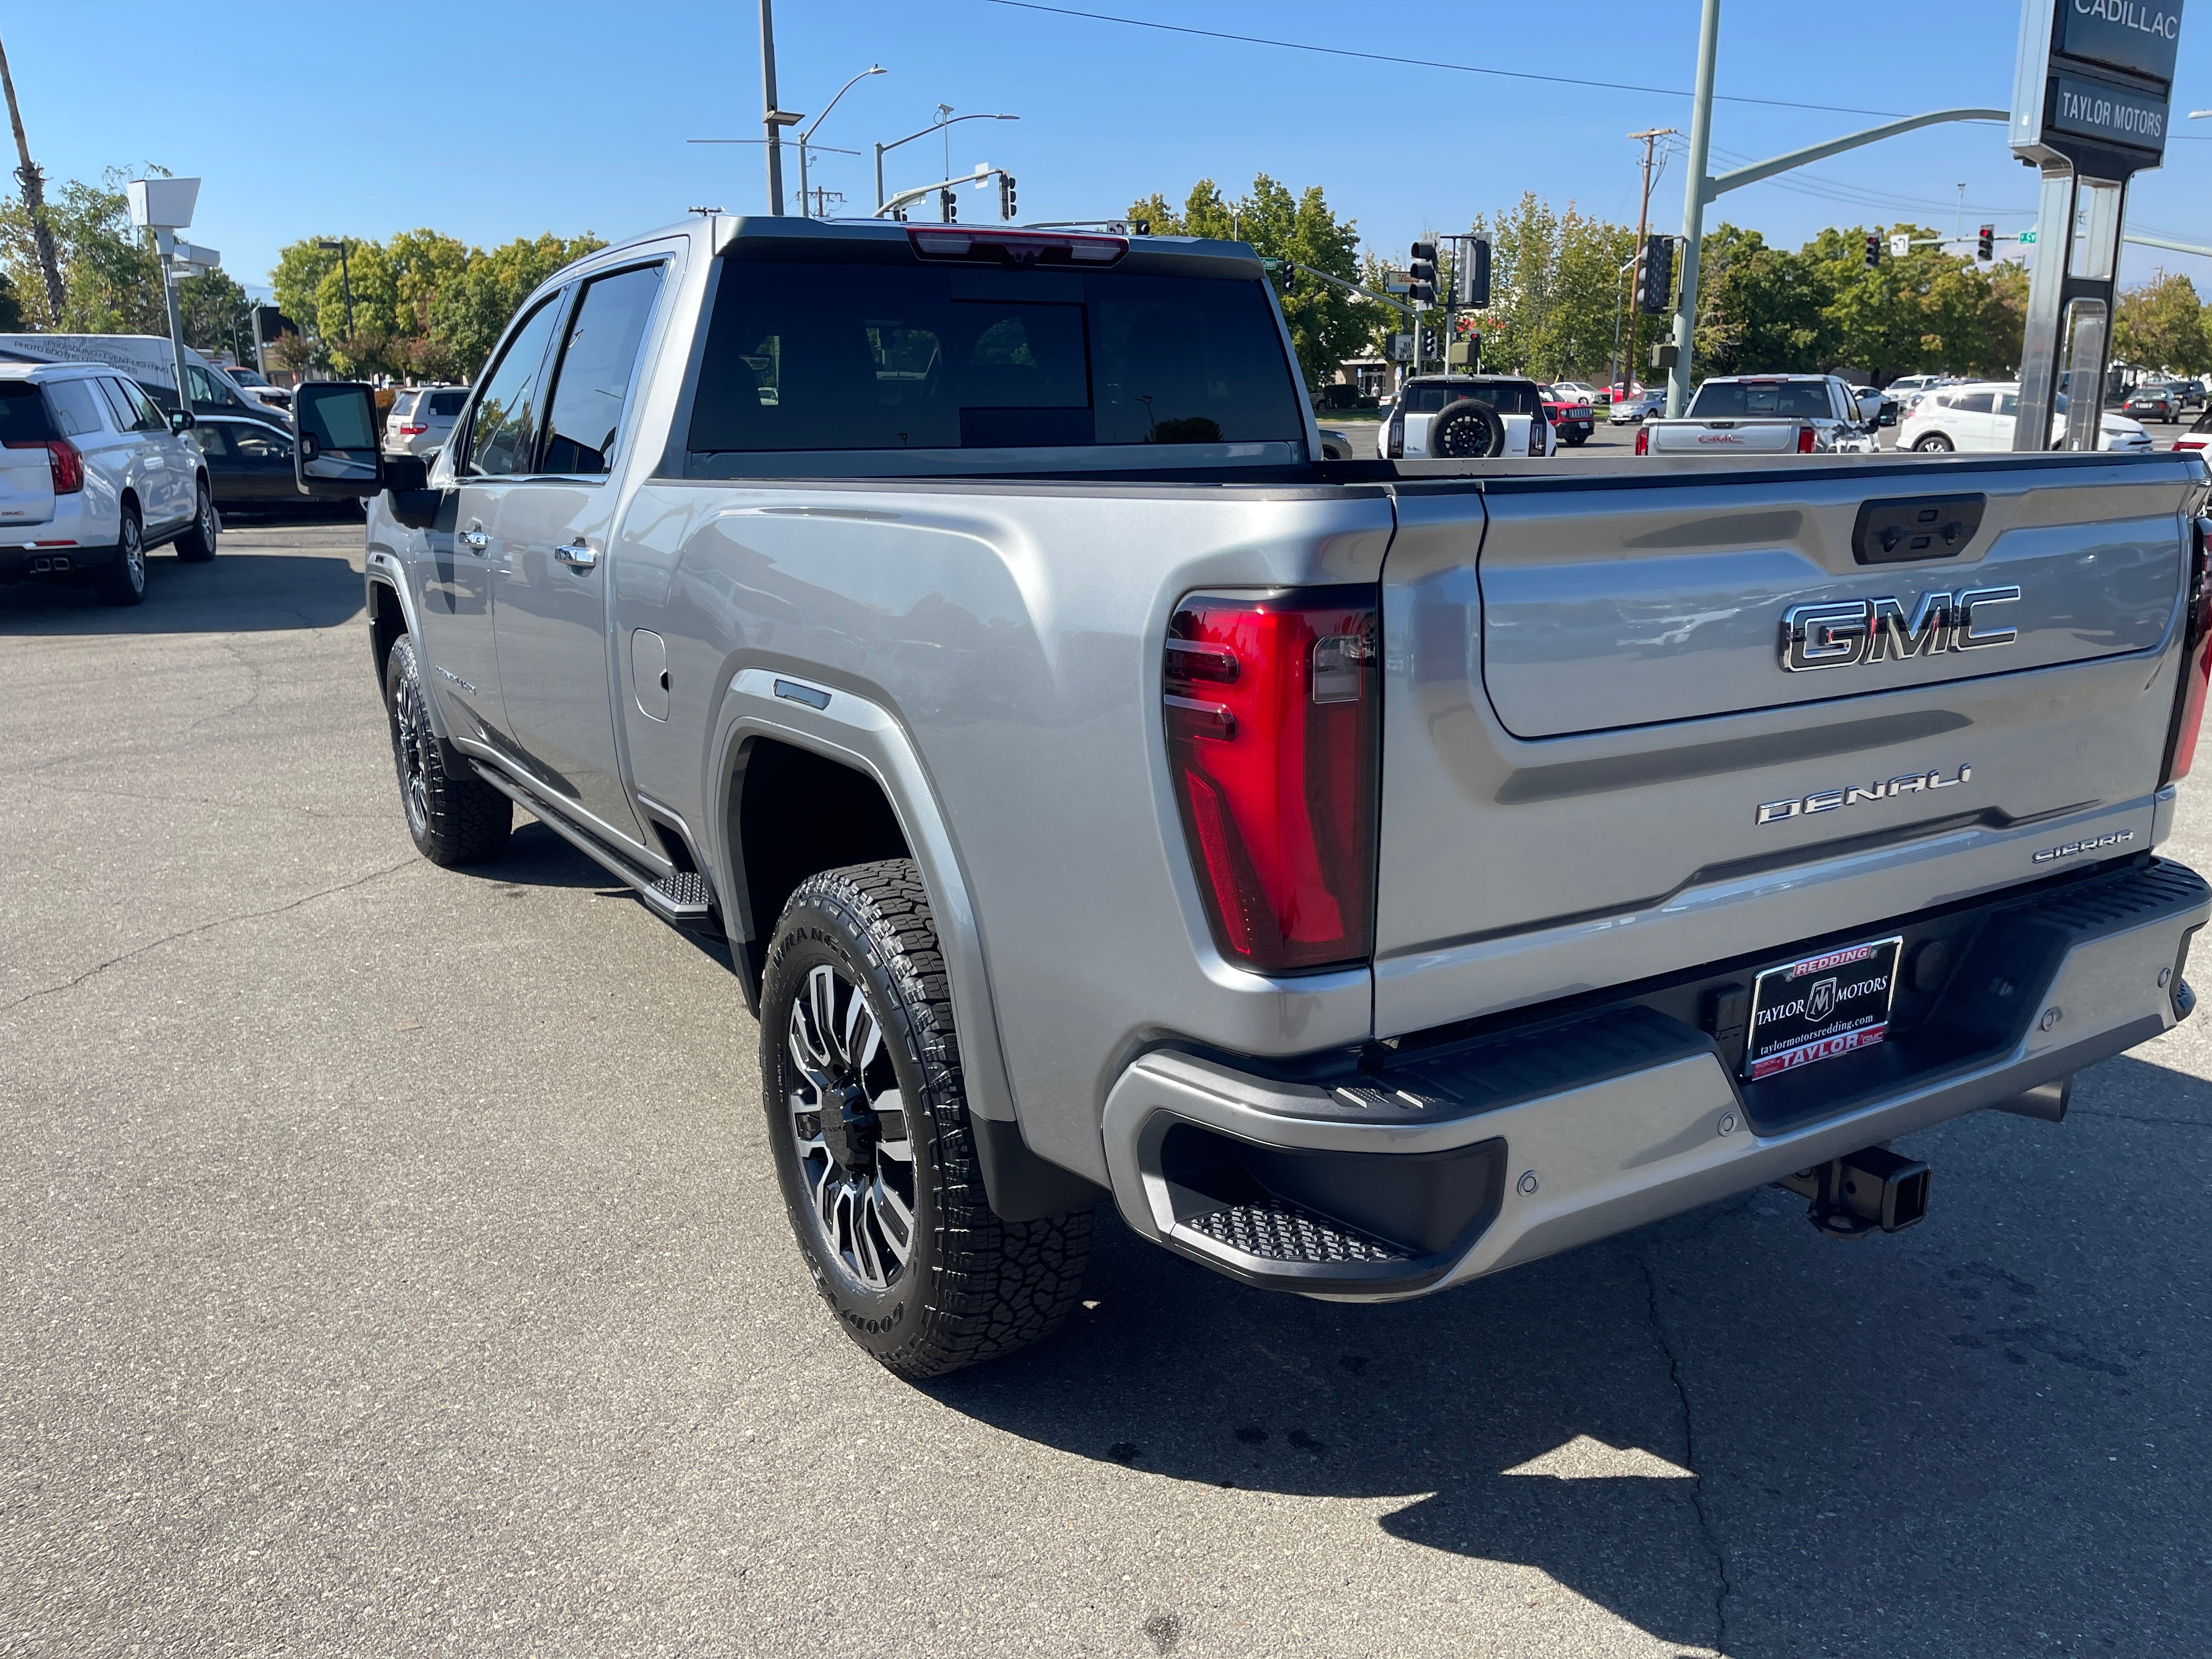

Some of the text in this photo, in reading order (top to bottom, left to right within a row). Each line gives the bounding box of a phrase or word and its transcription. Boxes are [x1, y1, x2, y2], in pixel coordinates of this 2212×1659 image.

[2074, 0, 2177, 40] CADILLAC
[2063, 92, 2162, 138] TAYLOR MOTORS
[1262, 259, 1276, 268] Creek
[14, 341, 43, 353] PHOTO
[103, 352, 129, 364] EVENT
[132, 360, 168, 374] LIGHTING
[1699, 434, 1745, 443] GMC
[1779, 584, 2021, 673] GMC
[1756, 763, 1971, 825] DENALI
[2032, 829, 2134, 863] SIERRA
[1796, 948, 1868, 975] REDDING
[1757, 999, 1805, 1026] TAYLOR
[1836, 975, 1888, 1002] MOTORS
[1756, 1031, 1883, 1069] BUICK TAYLOR GMC
[1760, 1014, 1873, 1055] taylormotorsredding.com
